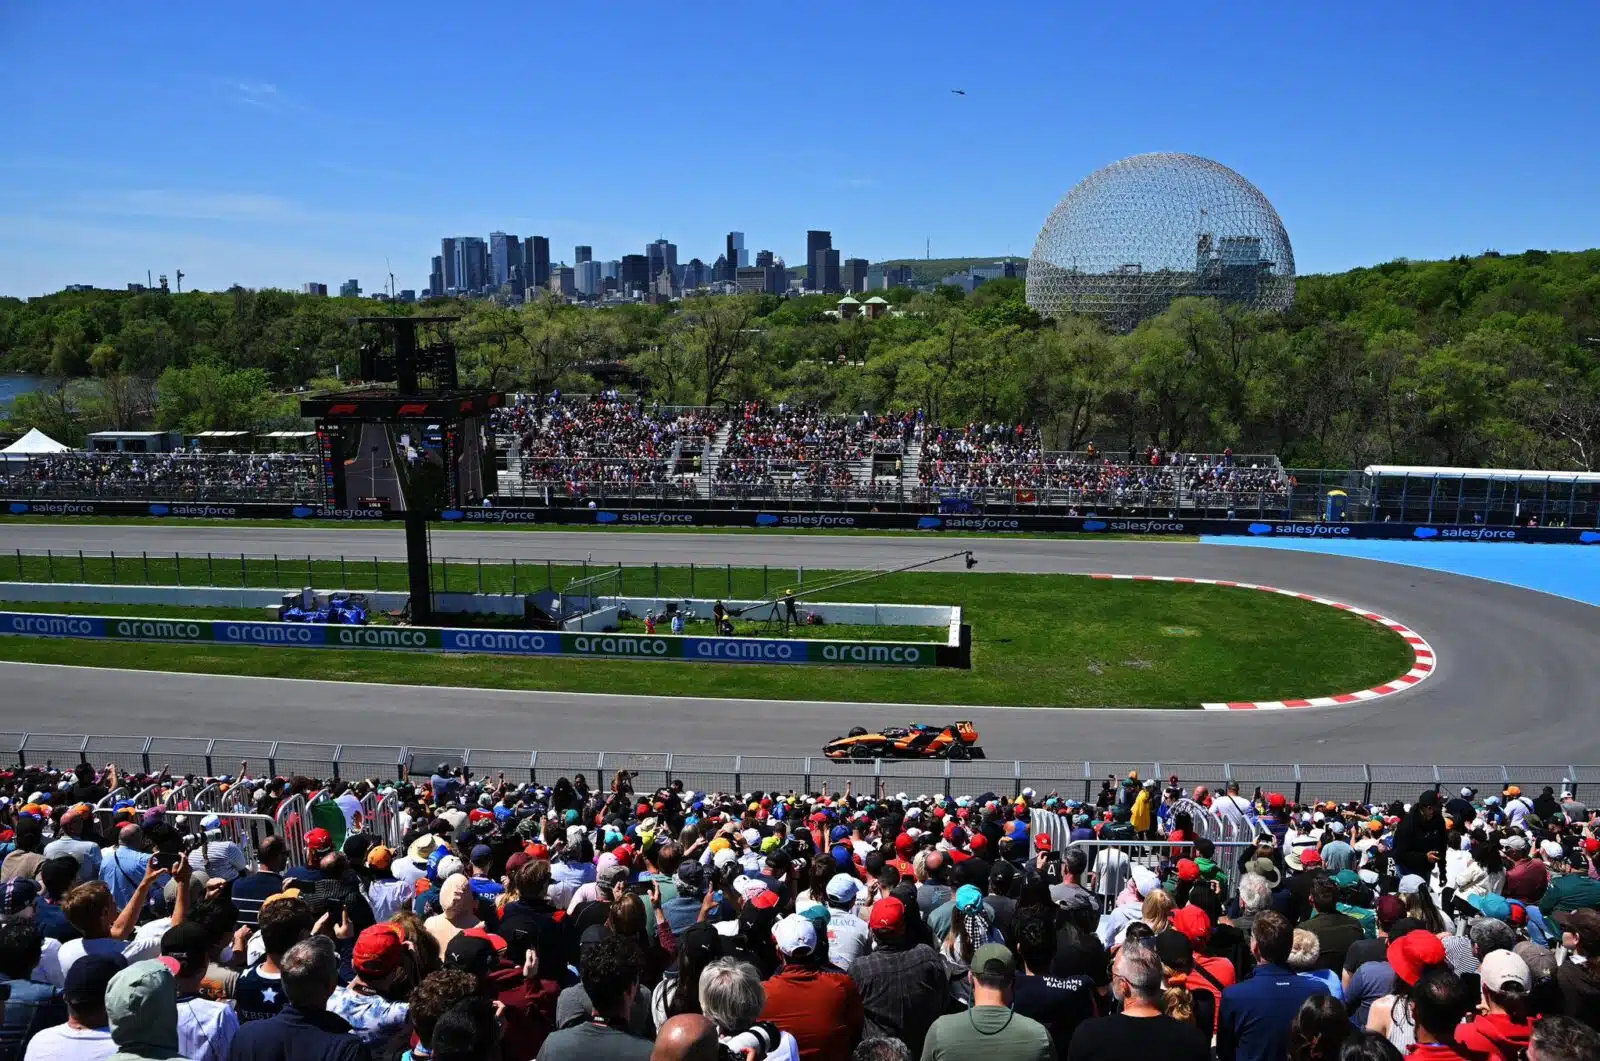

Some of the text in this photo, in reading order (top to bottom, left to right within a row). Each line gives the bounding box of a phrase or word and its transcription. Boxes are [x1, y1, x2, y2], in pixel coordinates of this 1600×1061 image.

[32, 504, 94, 513] salesforce
[172, 505, 236, 516] salesforce
[317, 507, 383, 518] salesforce
[467, 510, 535, 521] salesforce
[622, 511, 693, 523] salesforce
[782, 514, 854, 526] salesforce
[945, 517, 1019, 529] salesforce
[1110, 521, 1184, 532] salesforce
[1275, 524, 1350, 535] salesforce
[1441, 528, 1516, 539] salesforce
[12, 617, 92, 634] aramco
[118, 621, 200, 638] aramco
[227, 625, 312, 642] aramco
[339, 629, 427, 646] aramco
[456, 633, 545, 650] aramco
[574, 636, 667, 655] aramco
[697, 641, 792, 659] aramco
[822, 644, 920, 662] aramco
[1042, 975, 1082, 986] WILLIAMS
[1046, 981, 1077, 991] RACING
